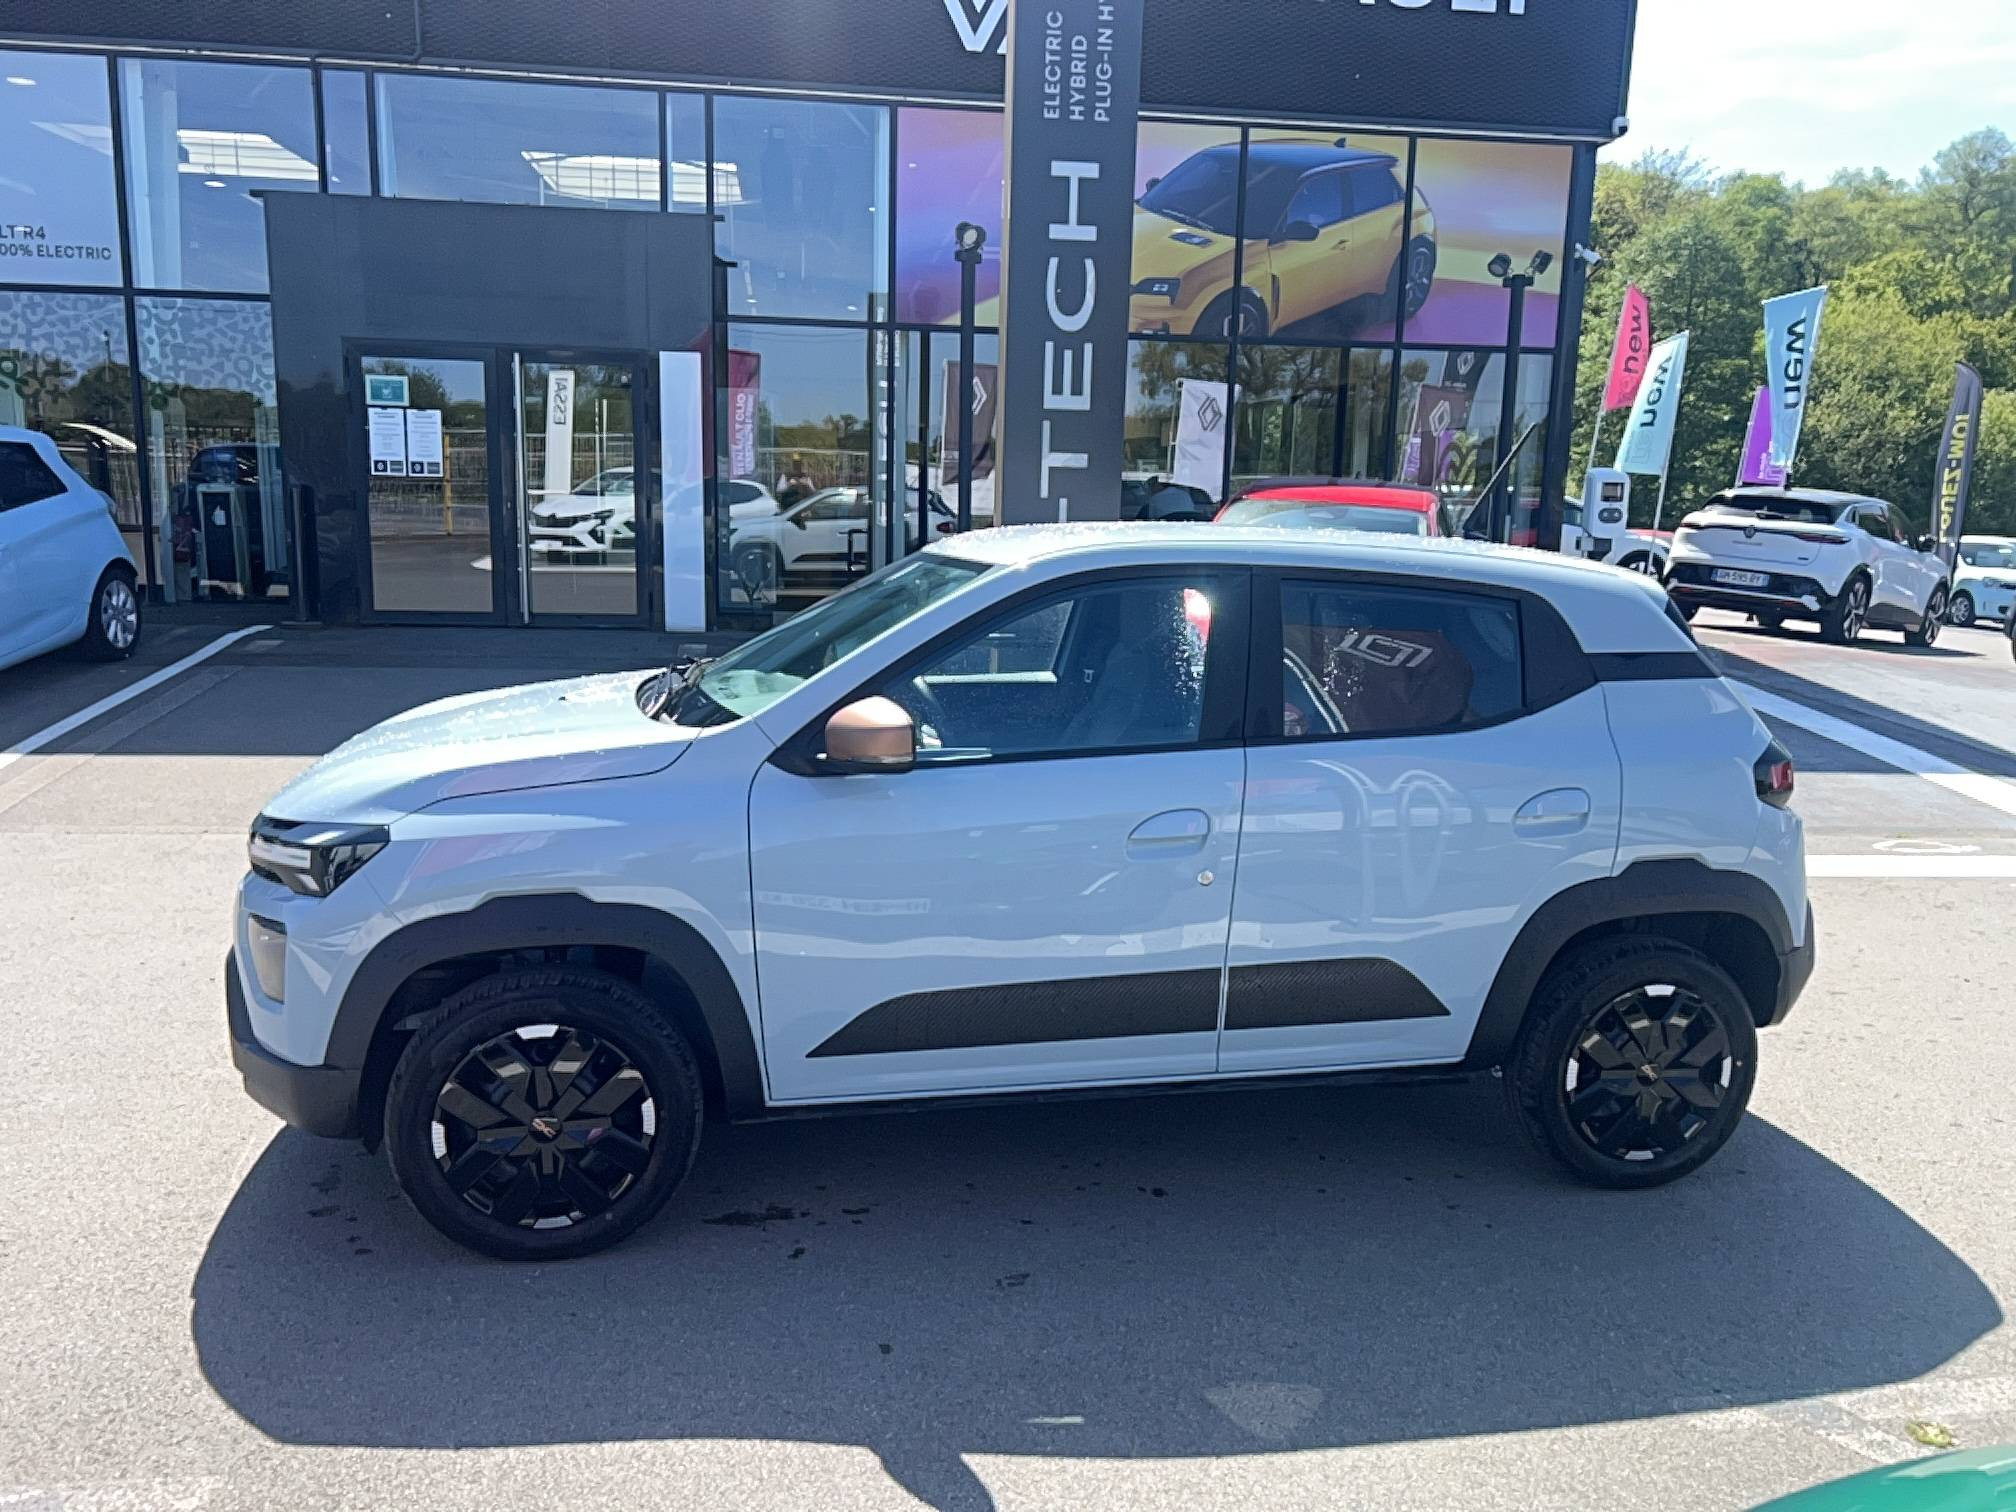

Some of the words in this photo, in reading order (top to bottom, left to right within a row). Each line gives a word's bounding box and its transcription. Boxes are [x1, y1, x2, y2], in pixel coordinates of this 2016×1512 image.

[1097, 0, 1114, 21] H
[1043, 10, 1063, 119] ELECTRIC
[1069, 34, 1088, 120] HYBRID
[1094, 28, 1114, 122] PLUG-IN
[23, 225, 46, 240] R4
[36, 244, 112, 260] ELECTRIC
